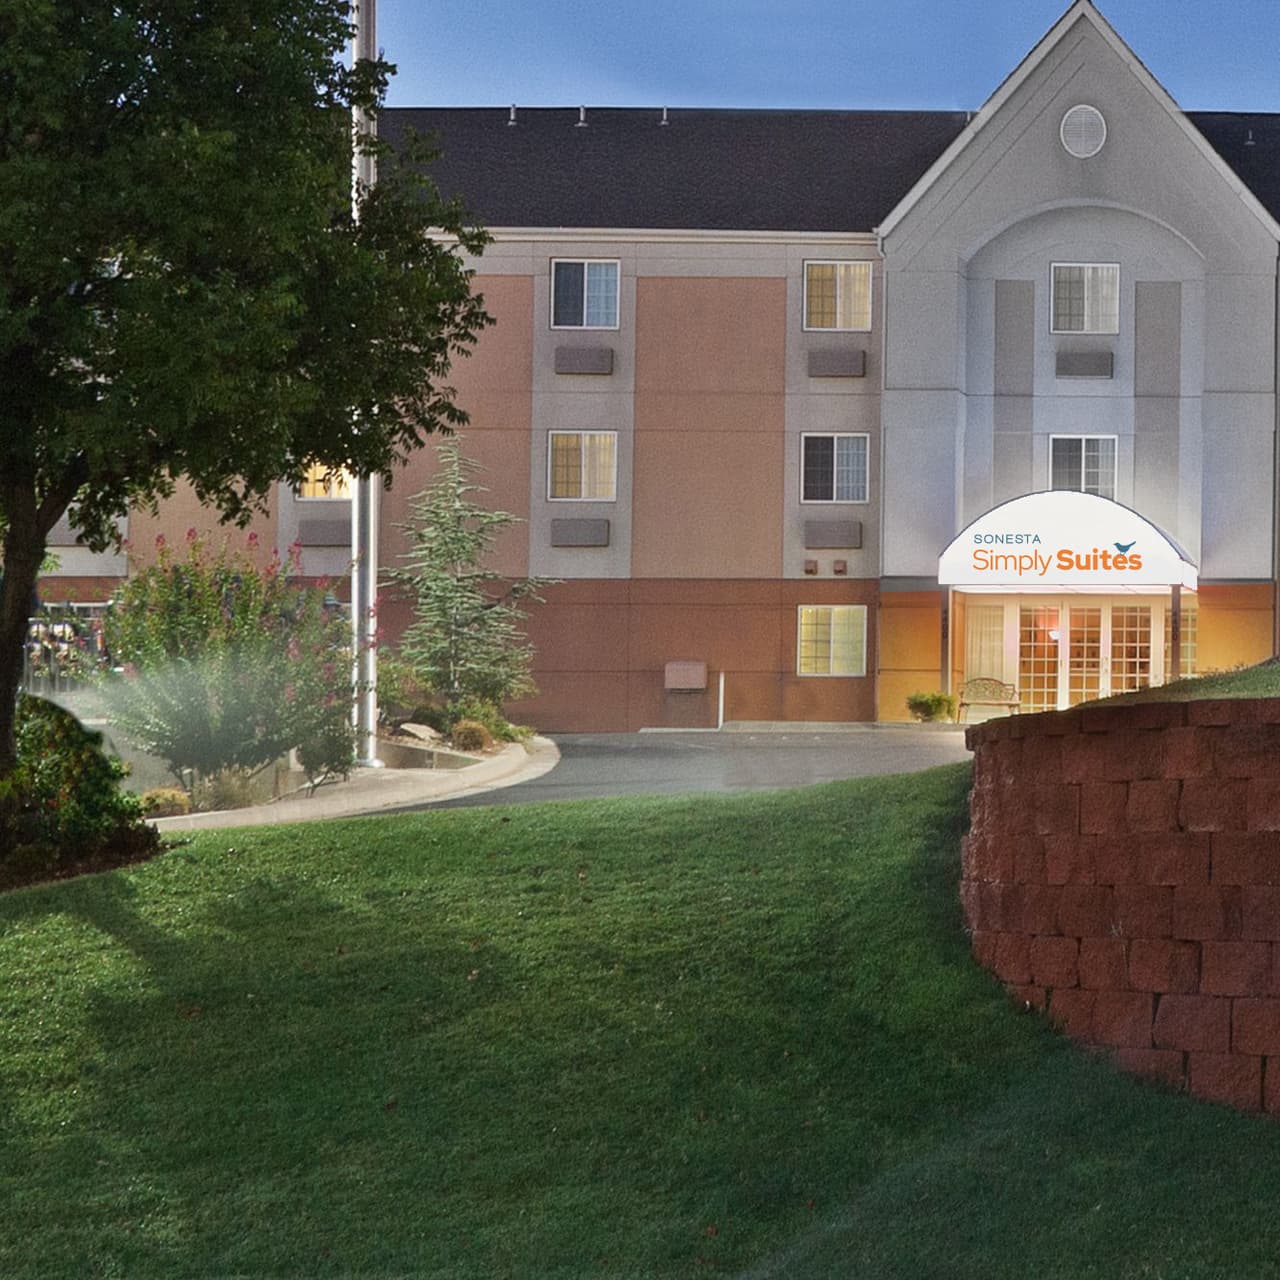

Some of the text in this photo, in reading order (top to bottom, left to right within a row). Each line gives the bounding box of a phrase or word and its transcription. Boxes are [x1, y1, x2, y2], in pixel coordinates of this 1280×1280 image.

[973, 534, 1042, 544] SONESTA
[972, 548, 1143, 576] Simply Suites
